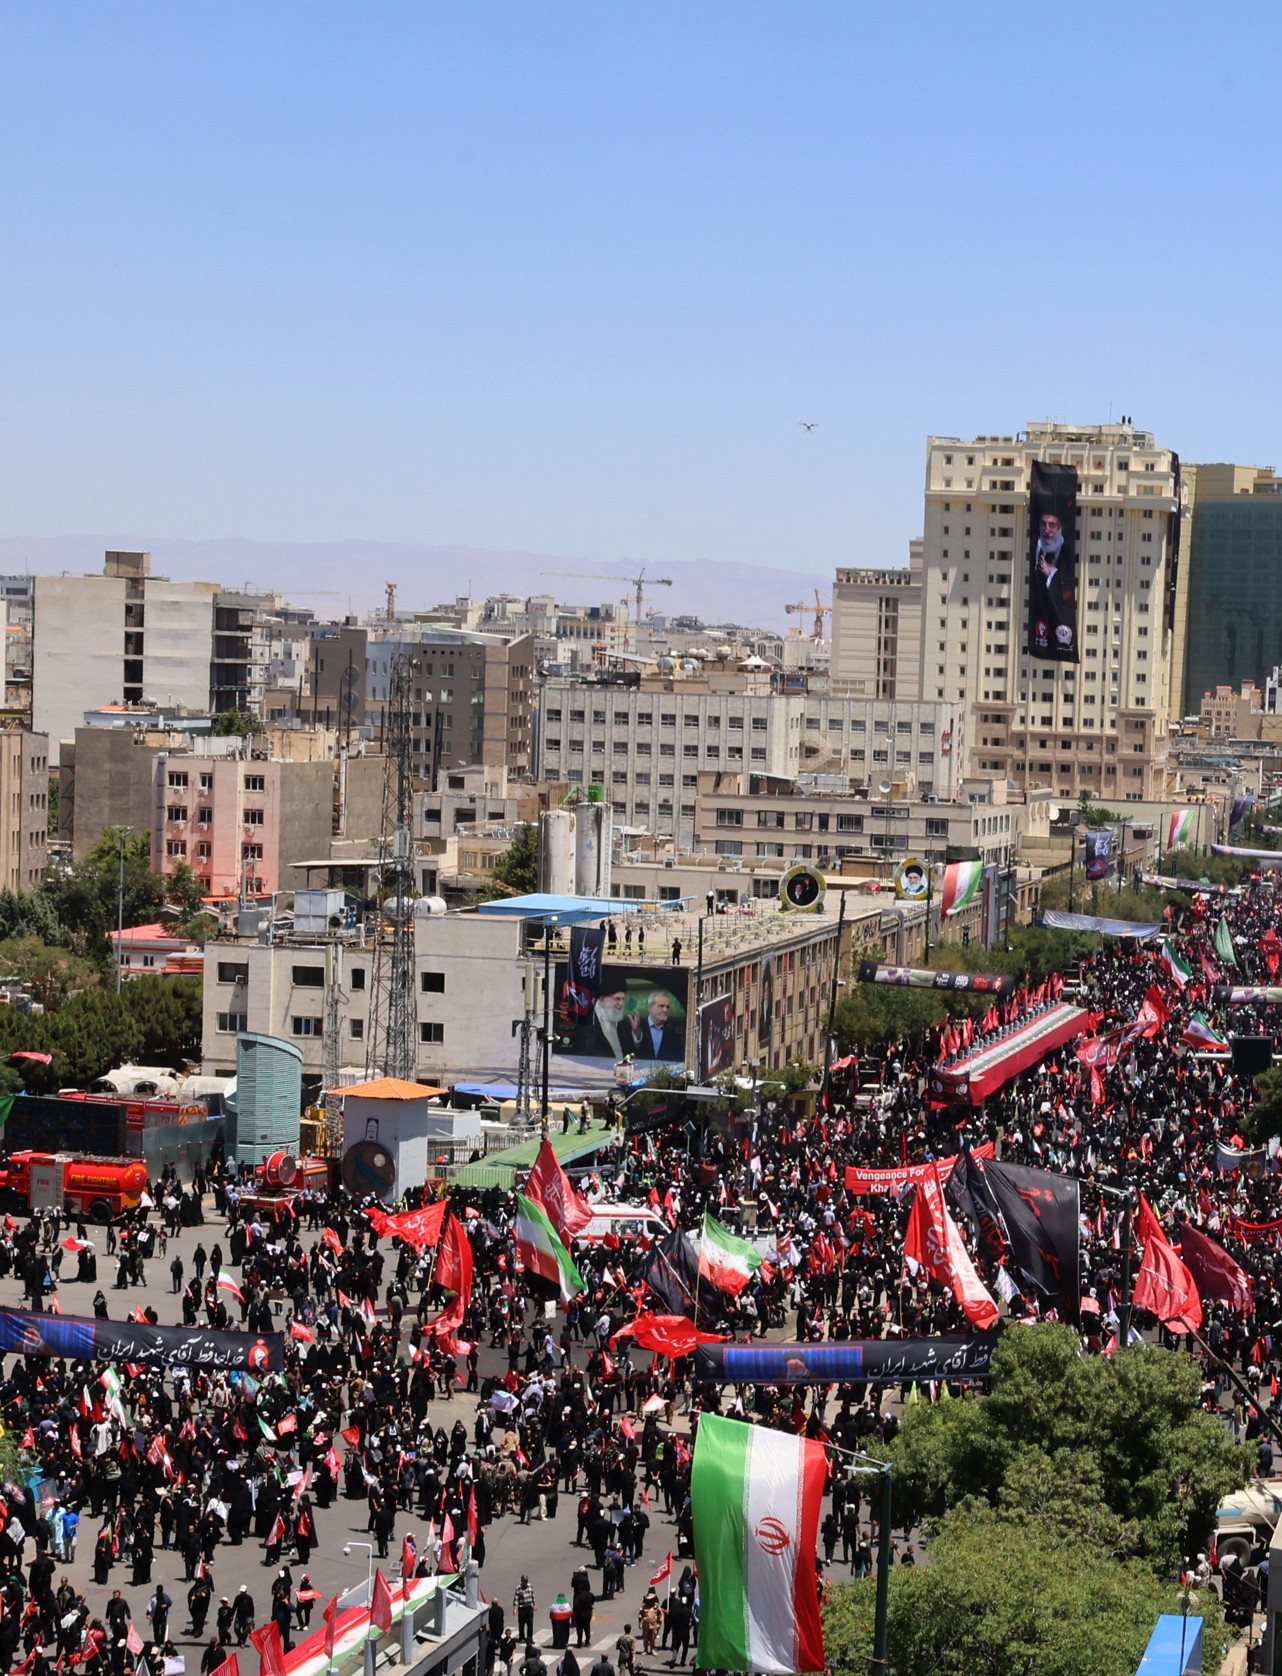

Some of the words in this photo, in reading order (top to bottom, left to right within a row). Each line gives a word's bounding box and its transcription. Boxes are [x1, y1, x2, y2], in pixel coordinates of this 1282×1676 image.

[71, 1174, 85, 1182] FIRE
[87, 1176, 117, 1185] FIGHTING
[856, 1170, 908, 1182] Vengeance
[910, 1168, 925, 1178] For
[97, 1340, 135, 1362] ایران
[136, 1336, 164, 1360] شهید
[163, 1335, 202, 1367] آقای
[909, 1347, 937, 1372] شهید
[935, 1340, 975, 1376] آقای
[866, 1356, 906, 1378] ایران
